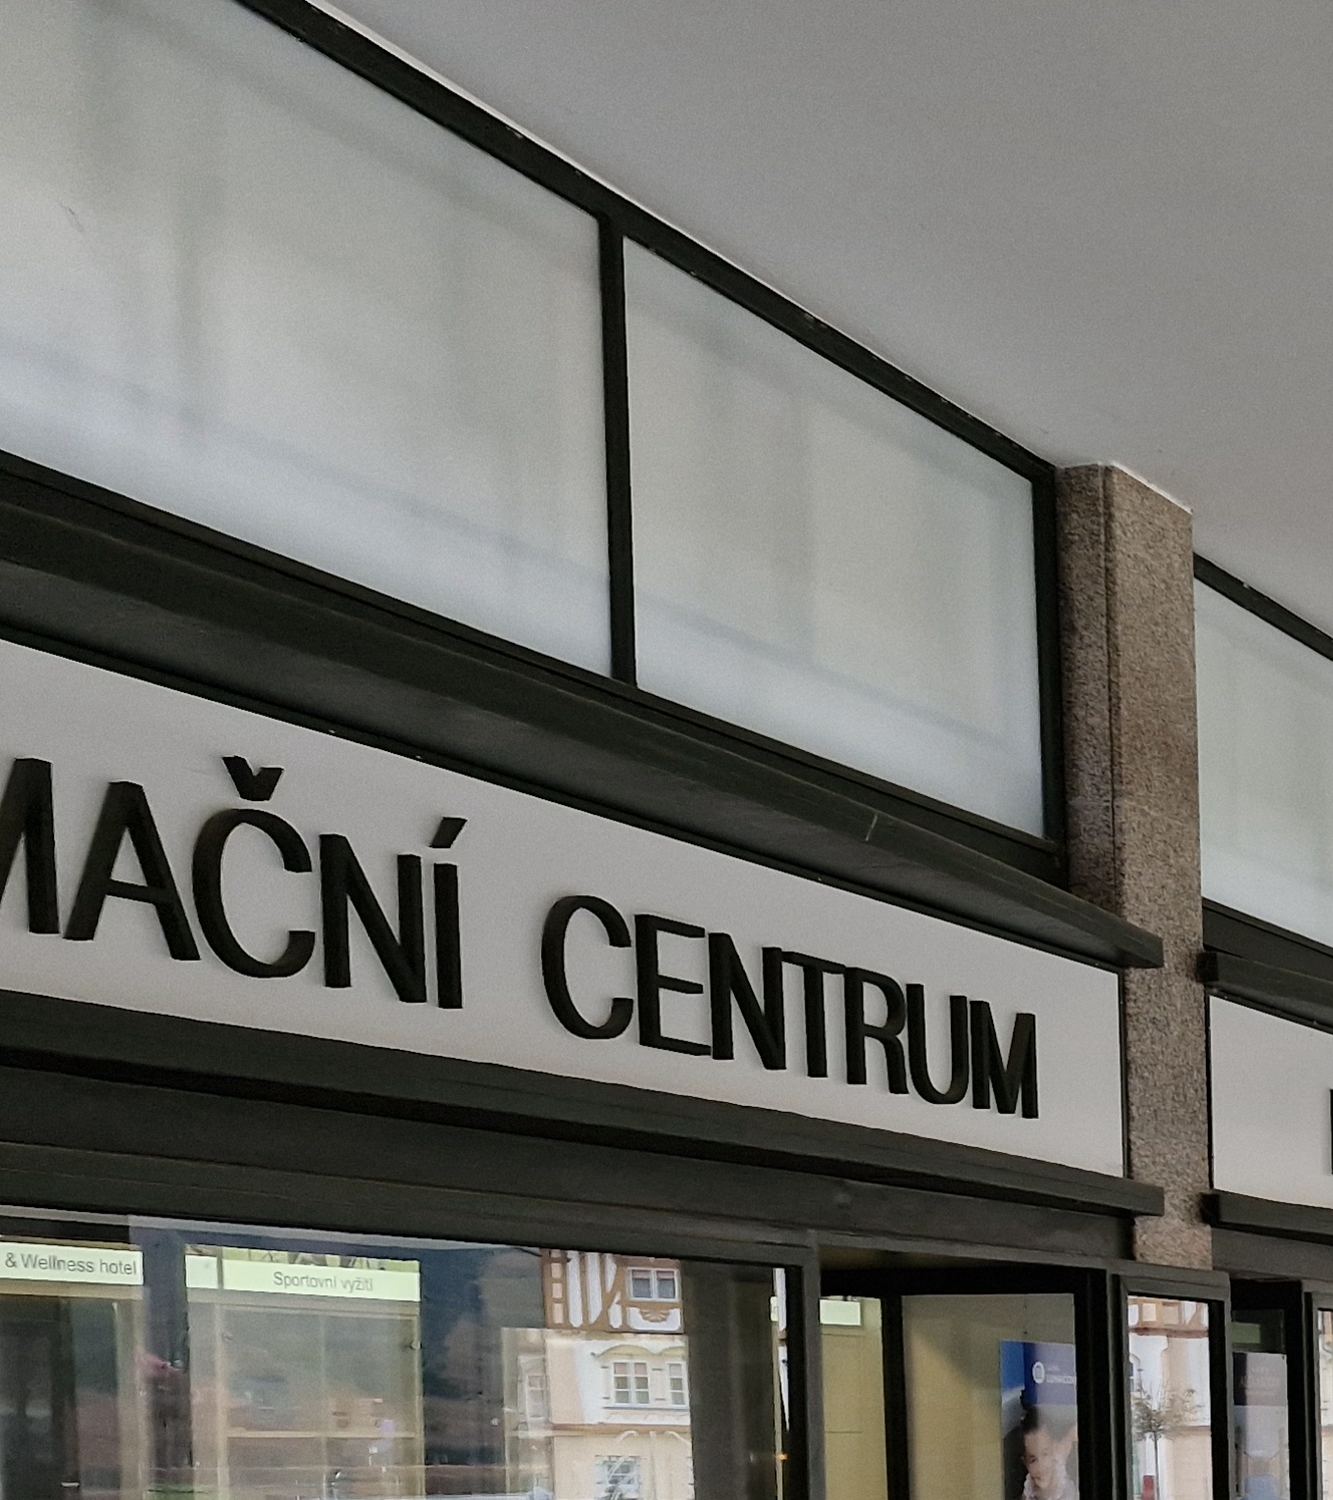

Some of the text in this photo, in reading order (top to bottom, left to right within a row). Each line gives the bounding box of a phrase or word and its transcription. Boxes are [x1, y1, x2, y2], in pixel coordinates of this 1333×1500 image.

[540, 894, 1039, 1119] CENTRUM
[4, 1251, 138, 1276] & Wellness hotel
[272, 1271, 374, 1294] Sportovní vyžití
